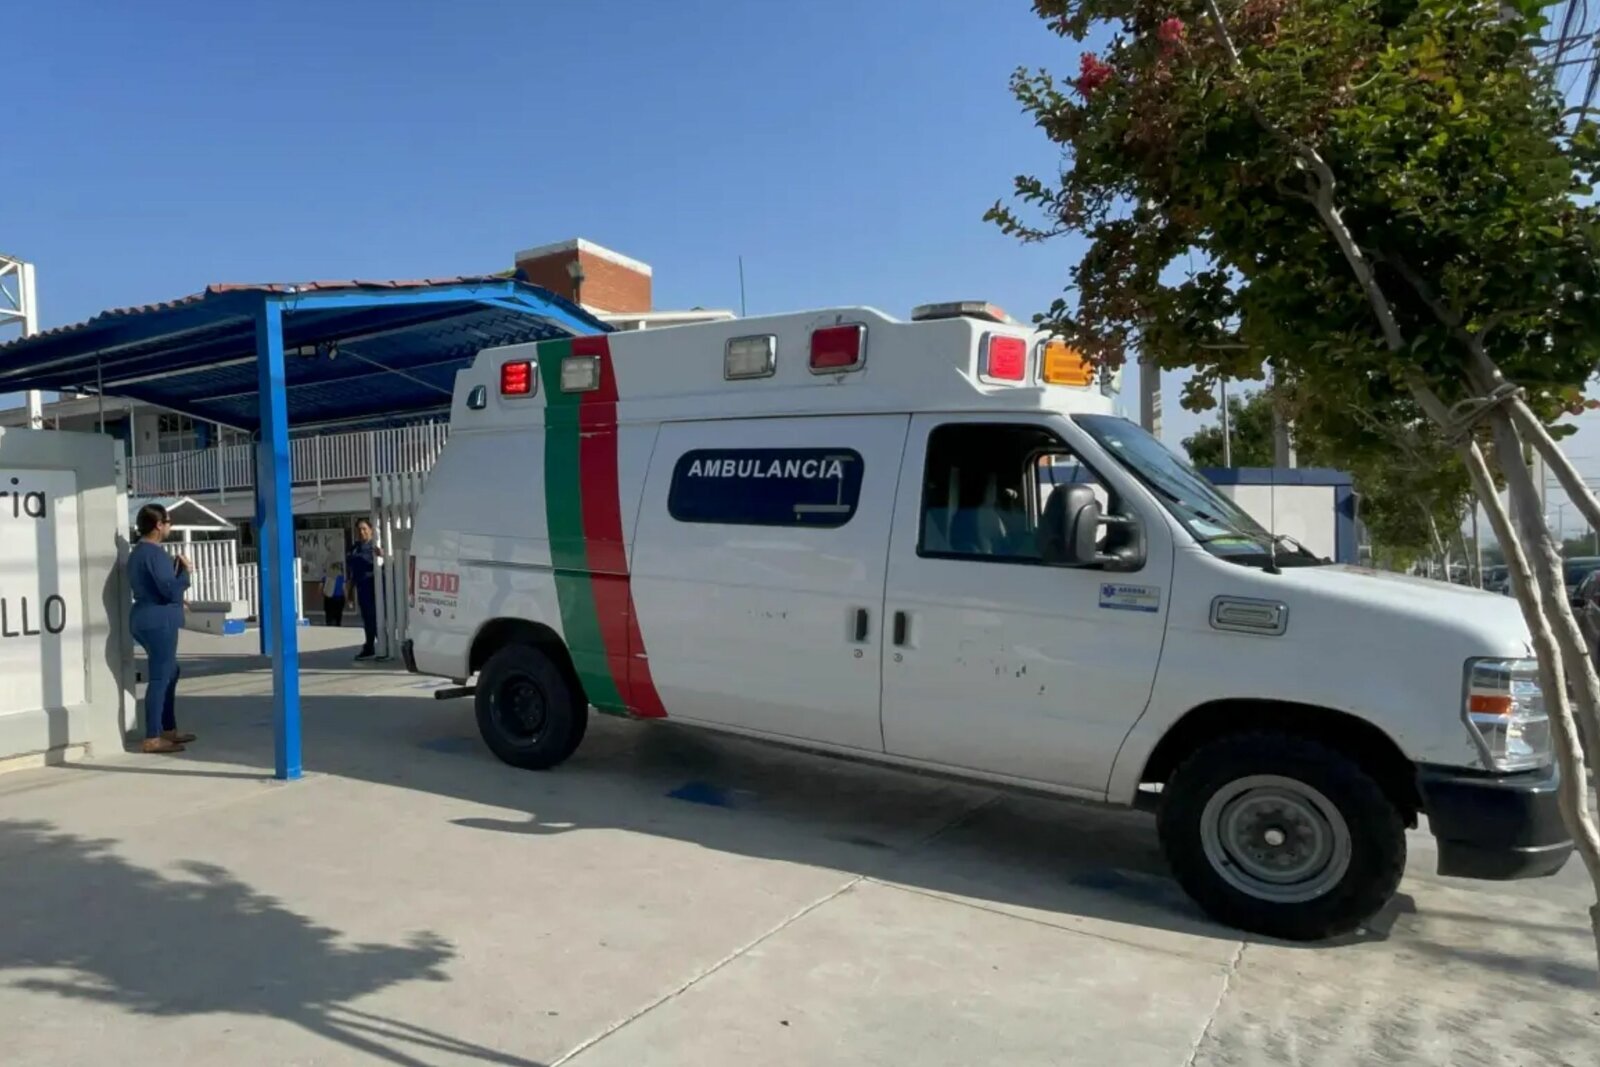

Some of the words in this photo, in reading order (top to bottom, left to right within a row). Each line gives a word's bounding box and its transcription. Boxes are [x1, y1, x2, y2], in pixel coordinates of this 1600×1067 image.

[688, 459, 843, 479] AMBULANCIA
[421, 573, 457, 591] 911
[1, 594, 67, 638] LLO
